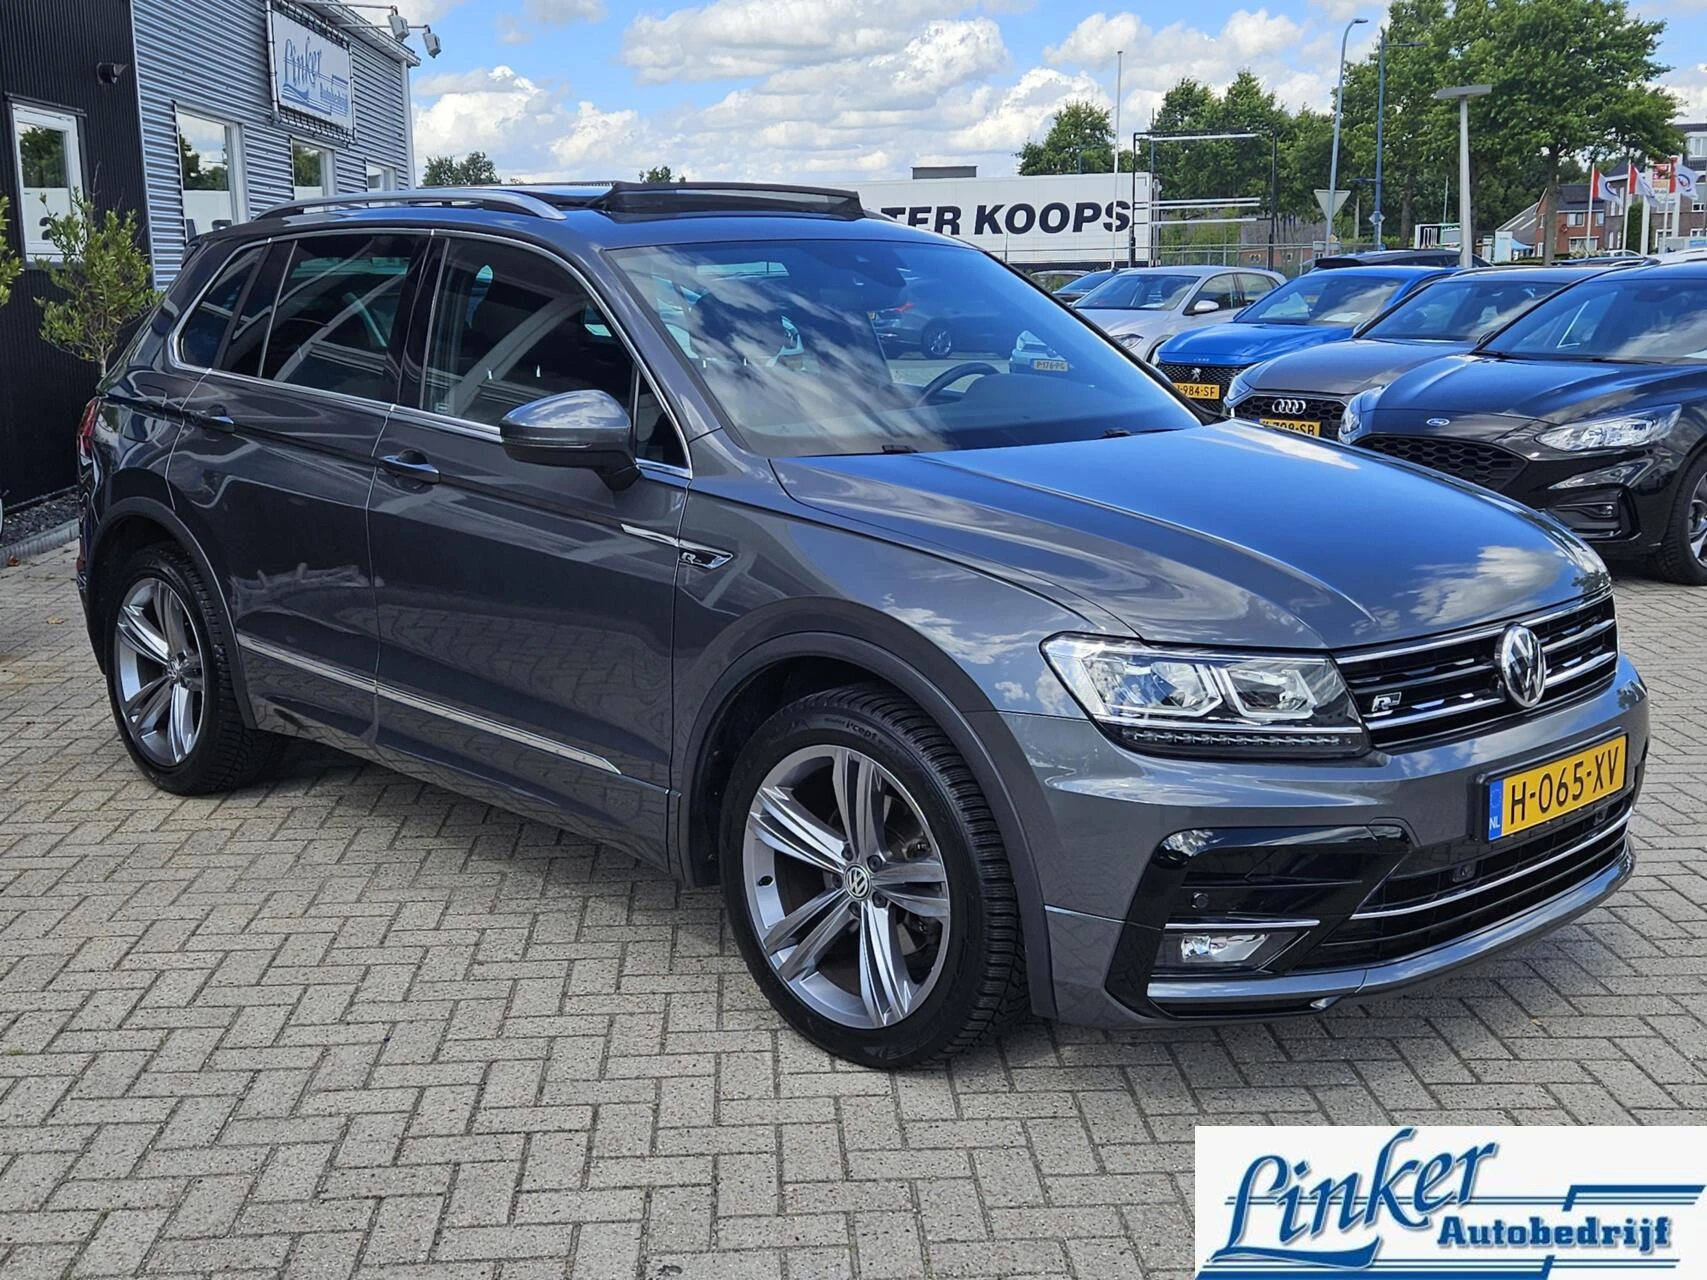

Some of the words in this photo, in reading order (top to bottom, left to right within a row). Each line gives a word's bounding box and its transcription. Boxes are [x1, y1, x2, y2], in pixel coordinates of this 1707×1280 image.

[282, 36, 322, 98] Linker
[974, 200, 1131, 235] KOOPS
[1510, 746, 1619, 825] H-065-XV
[1489, 816, 1501, 829] NL
